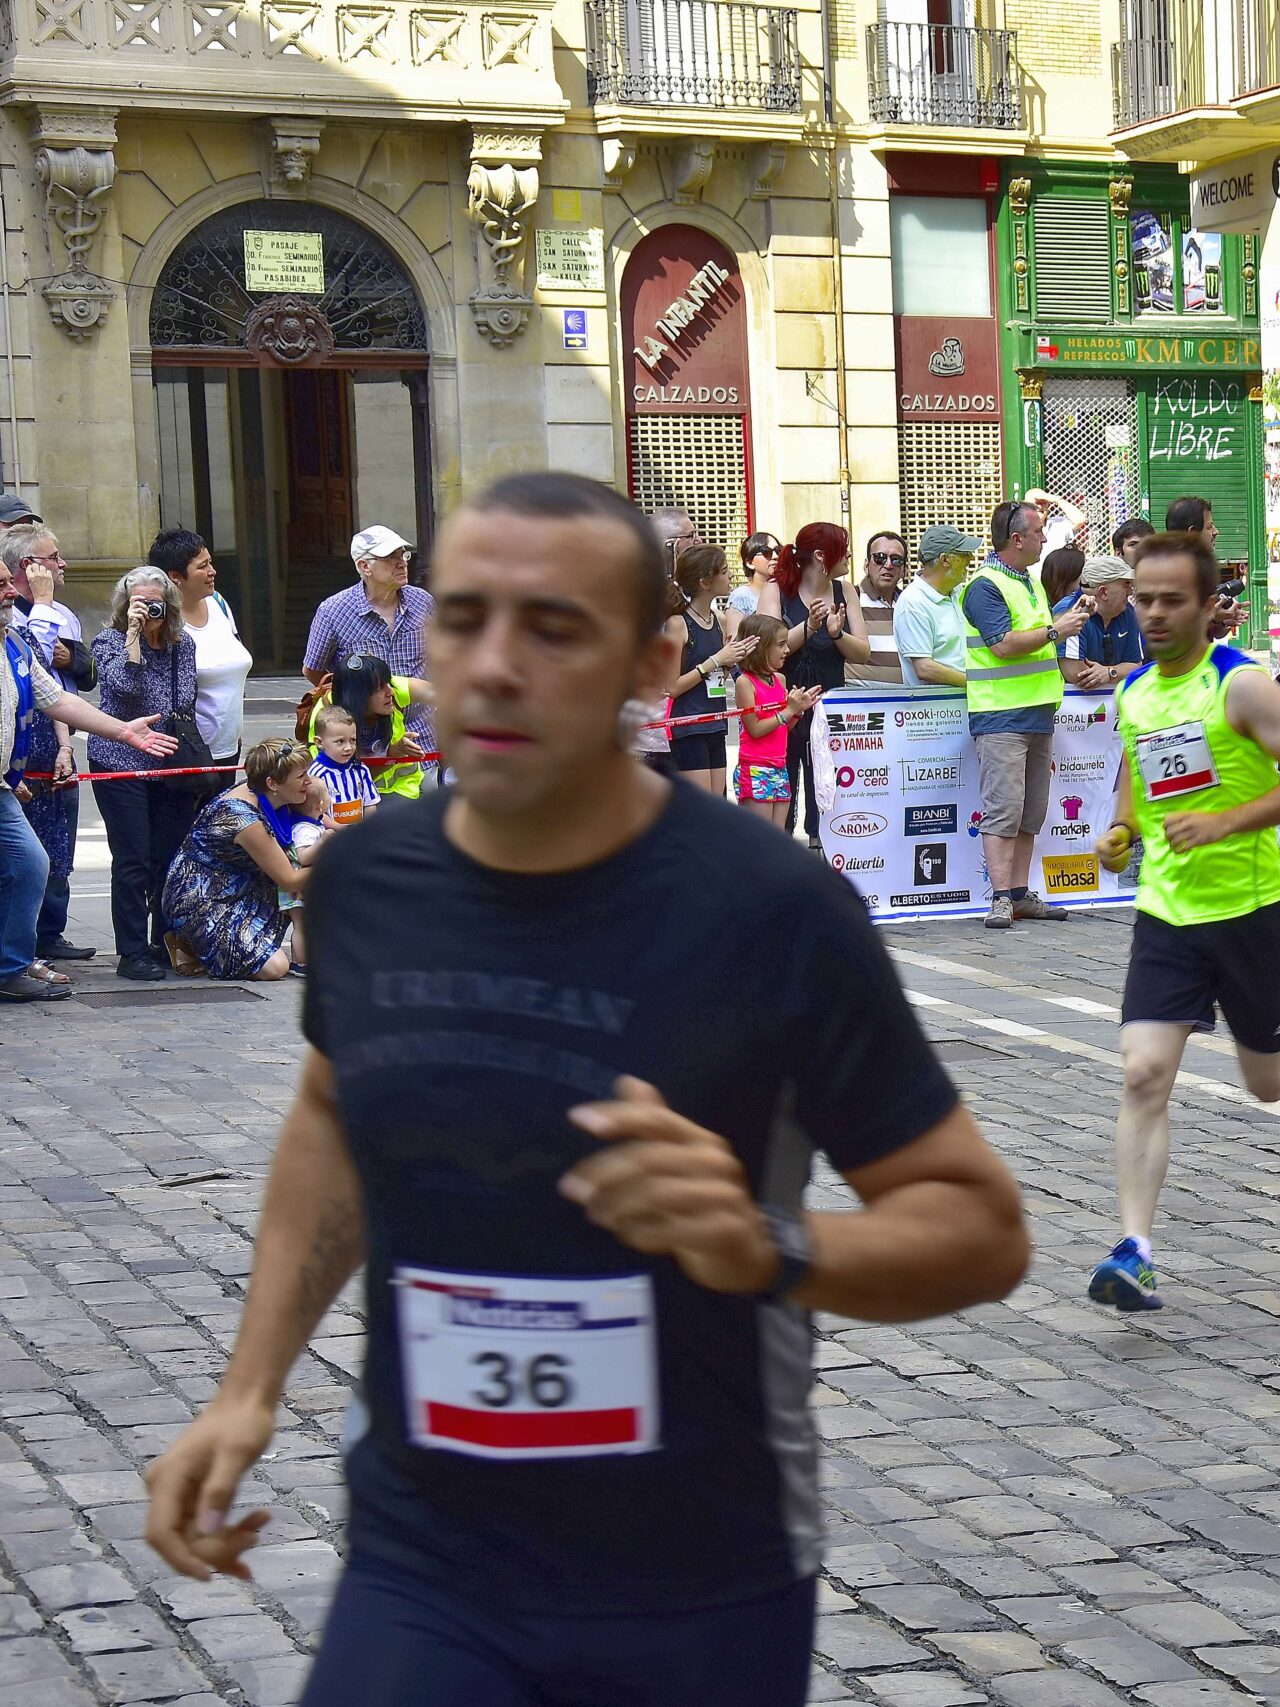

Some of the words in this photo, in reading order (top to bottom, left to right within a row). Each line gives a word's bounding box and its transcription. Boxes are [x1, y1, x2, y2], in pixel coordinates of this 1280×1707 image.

[1200, 173, 1254, 207] WELCOME
[271, 241, 299, 250] PASAJE
[284, 252, 318, 261] SEMINARIO
[543, 248, 556, 256] SAN
[562, 249, 597, 257] SATURNINO
[281, 265, 319, 274] SEMINARIO
[542, 262, 557, 270] SAN
[562, 262, 599, 271] SATURNINO
[264, 273, 306, 283] PASABIDEA
[560, 273, 581, 281] KALEA
[633, 335, 668, 368] LA
[655, 260, 730, 342] INFANTIL
[1067, 337, 1122, 348] HELADOS
[1063, 350, 1127, 362] REFRESCOS
[1135, 337, 1182, 364] KM
[633, 385, 738, 403] CALZADOS
[1154, 376, 1240, 418] KOLDO
[900, 394, 996, 411] CALZADOS
[1149, 419, 1235, 462] LIBRE
[894, 709, 962, 728] goxoki-rotxa
[846, 722, 866, 731] Motos
[1066, 725, 1085, 733] kutxa
[843, 737, 884, 751] YAMAHA
[857, 765, 889, 778] canal
[1060, 760, 1105, 772] bidaurreta
[1160, 754, 1187, 779] 26
[907, 766, 957, 782] LIZARBE
[863, 777, 889, 788] cero
[912, 808, 950, 821] BIANBI
[837, 822, 880, 835] AROMA
[1051, 822, 1091, 838] markaje
[845, 856, 885, 871] divertis
[1046, 861, 1085, 870] INMOBILIARIA
[1048, 870, 1095, 888] urbasa
[891, 894, 930, 906] ALBERTO
[470, 1351, 576, 1409] 36
